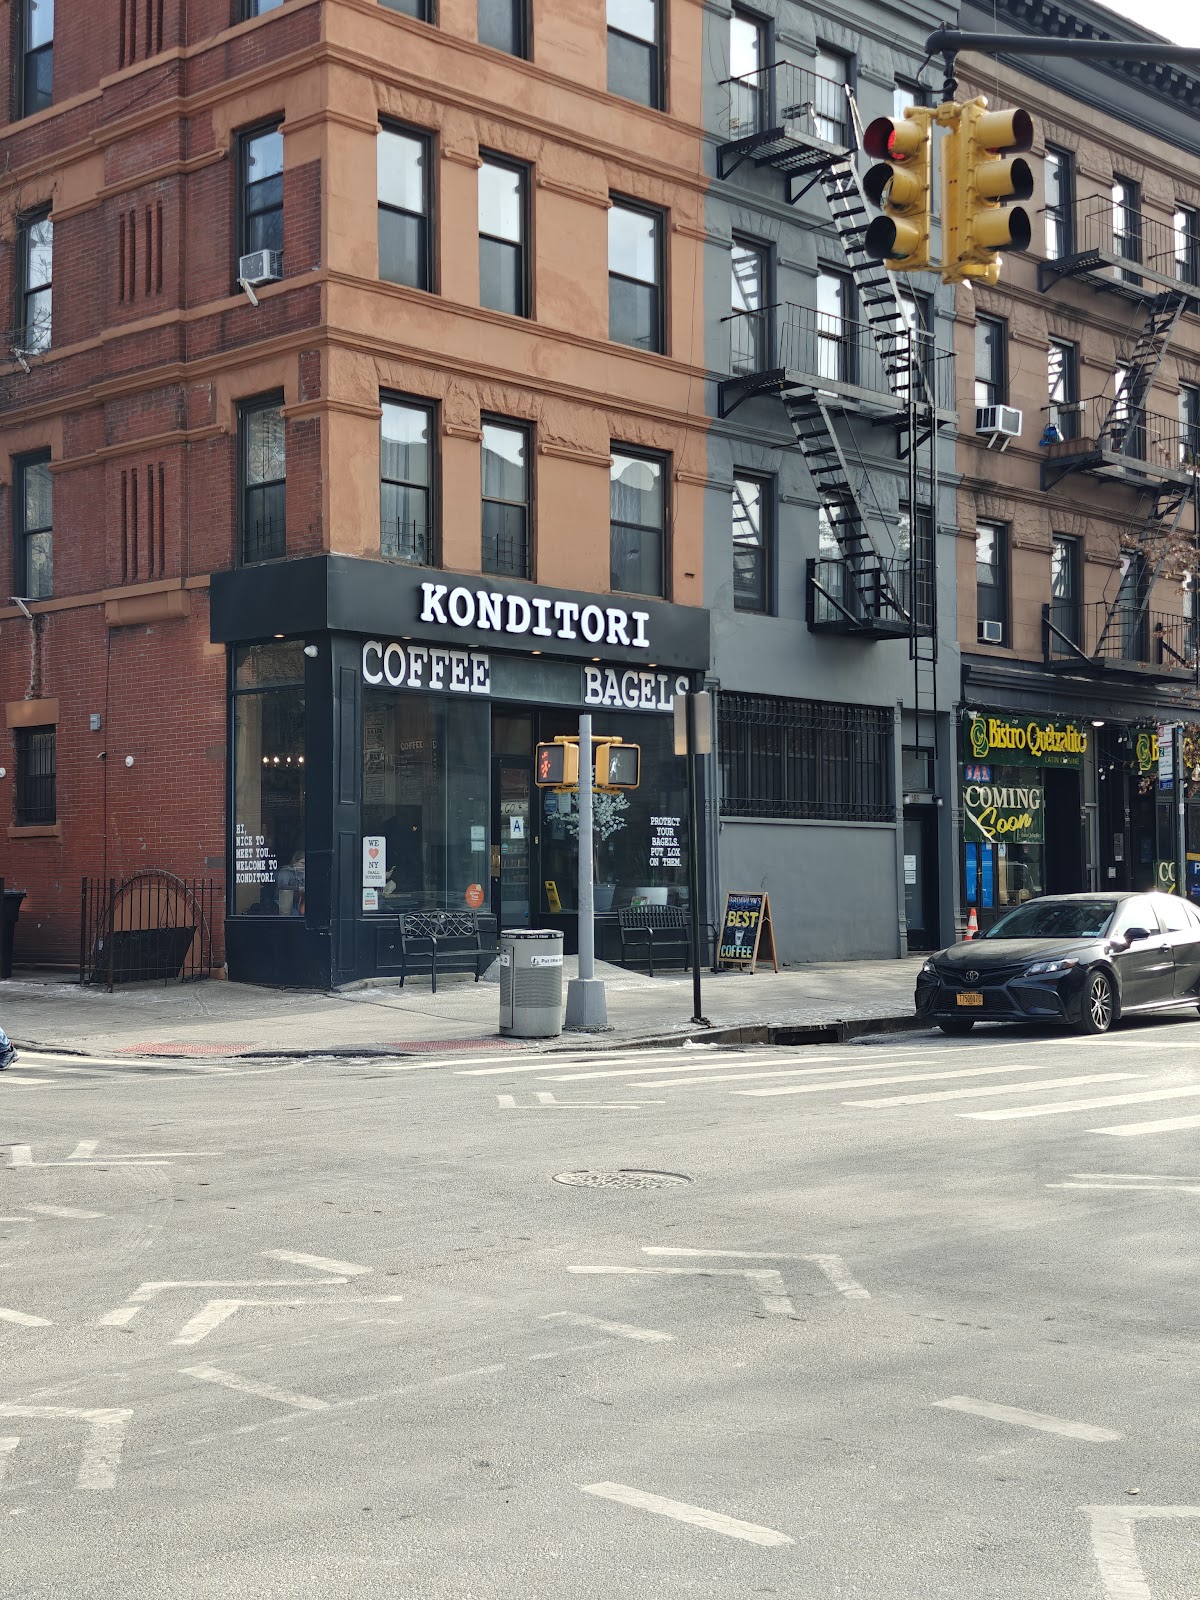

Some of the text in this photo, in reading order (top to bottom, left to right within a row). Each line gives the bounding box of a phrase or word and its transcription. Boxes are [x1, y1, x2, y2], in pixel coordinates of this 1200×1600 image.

[420, 582, 650, 648] KONDITORI
[362, 640, 491, 694] COFFEE
[988, 719, 1087, 757] Bistro Quetzalito
[400, 741, 424, 750] COFFEE
[965, 786, 1040, 809] COMING
[513, 820, 521, 832] A
[650, 817, 680, 826] PROTECT
[979, 807, 1032, 838] Soon
[236, 824, 247, 835] HI,
[656, 827, 674, 836] YOUR
[236, 836, 265, 847] NICE TO
[651, 837, 680, 846] BAGELS.
[236, 848, 276, 859] MEET YOU...
[650, 848, 681, 856] PUT LOX
[236, 860, 278, 871] WELCOME TO
[650, 858, 682, 867] ON THEM.
[236, 873, 276, 883] KONDITORI.
[727, 911, 759, 928] BEST
[720, 945, 753, 959] COFFEE
